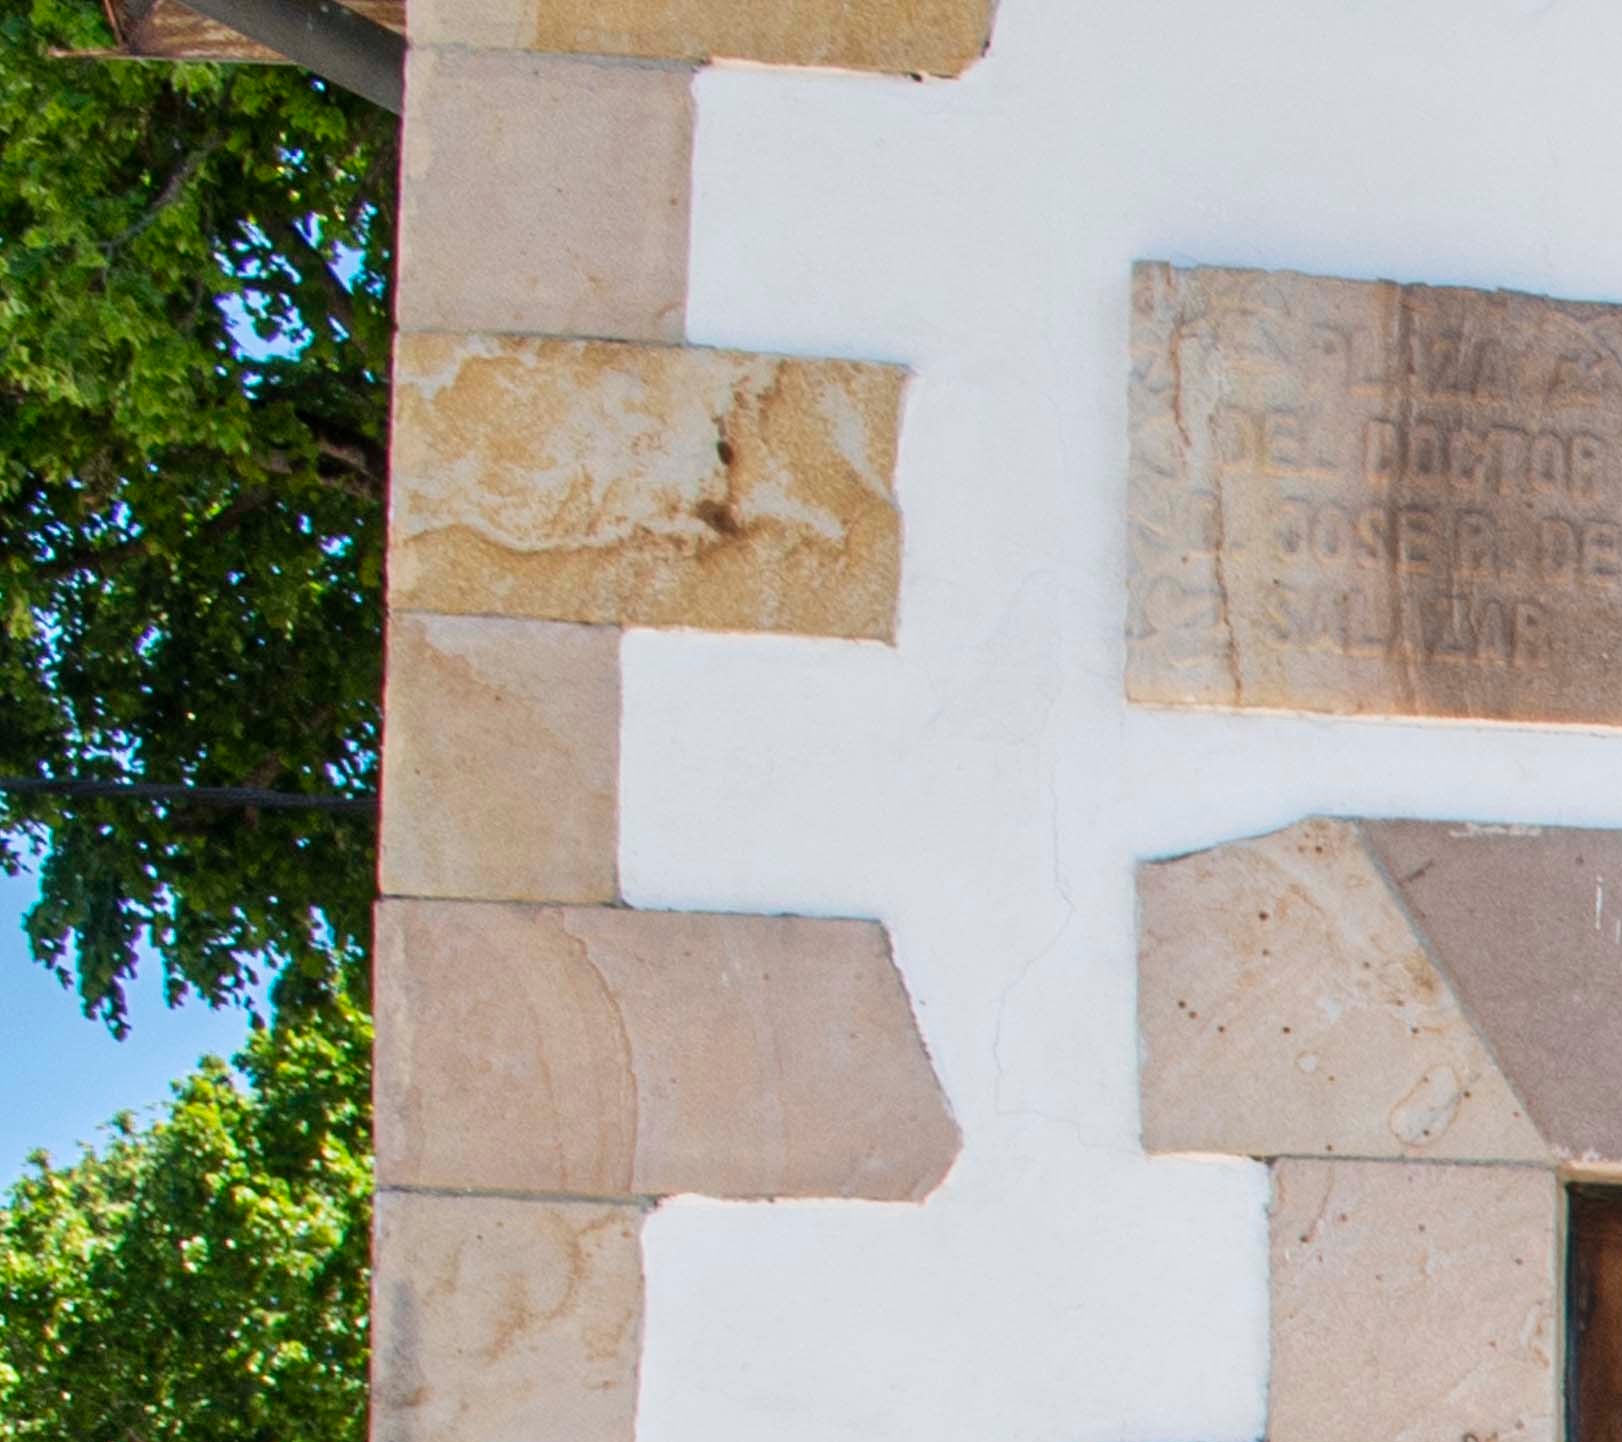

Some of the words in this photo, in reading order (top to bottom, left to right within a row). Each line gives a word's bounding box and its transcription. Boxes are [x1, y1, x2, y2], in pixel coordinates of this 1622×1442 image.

[1363, 417, 1604, 501] DOCTOR
[1269, 495, 1433, 575] JOSE
[1541, 515, 1620, 587] DE
[1263, 582, 1547, 667] SALAZAR
